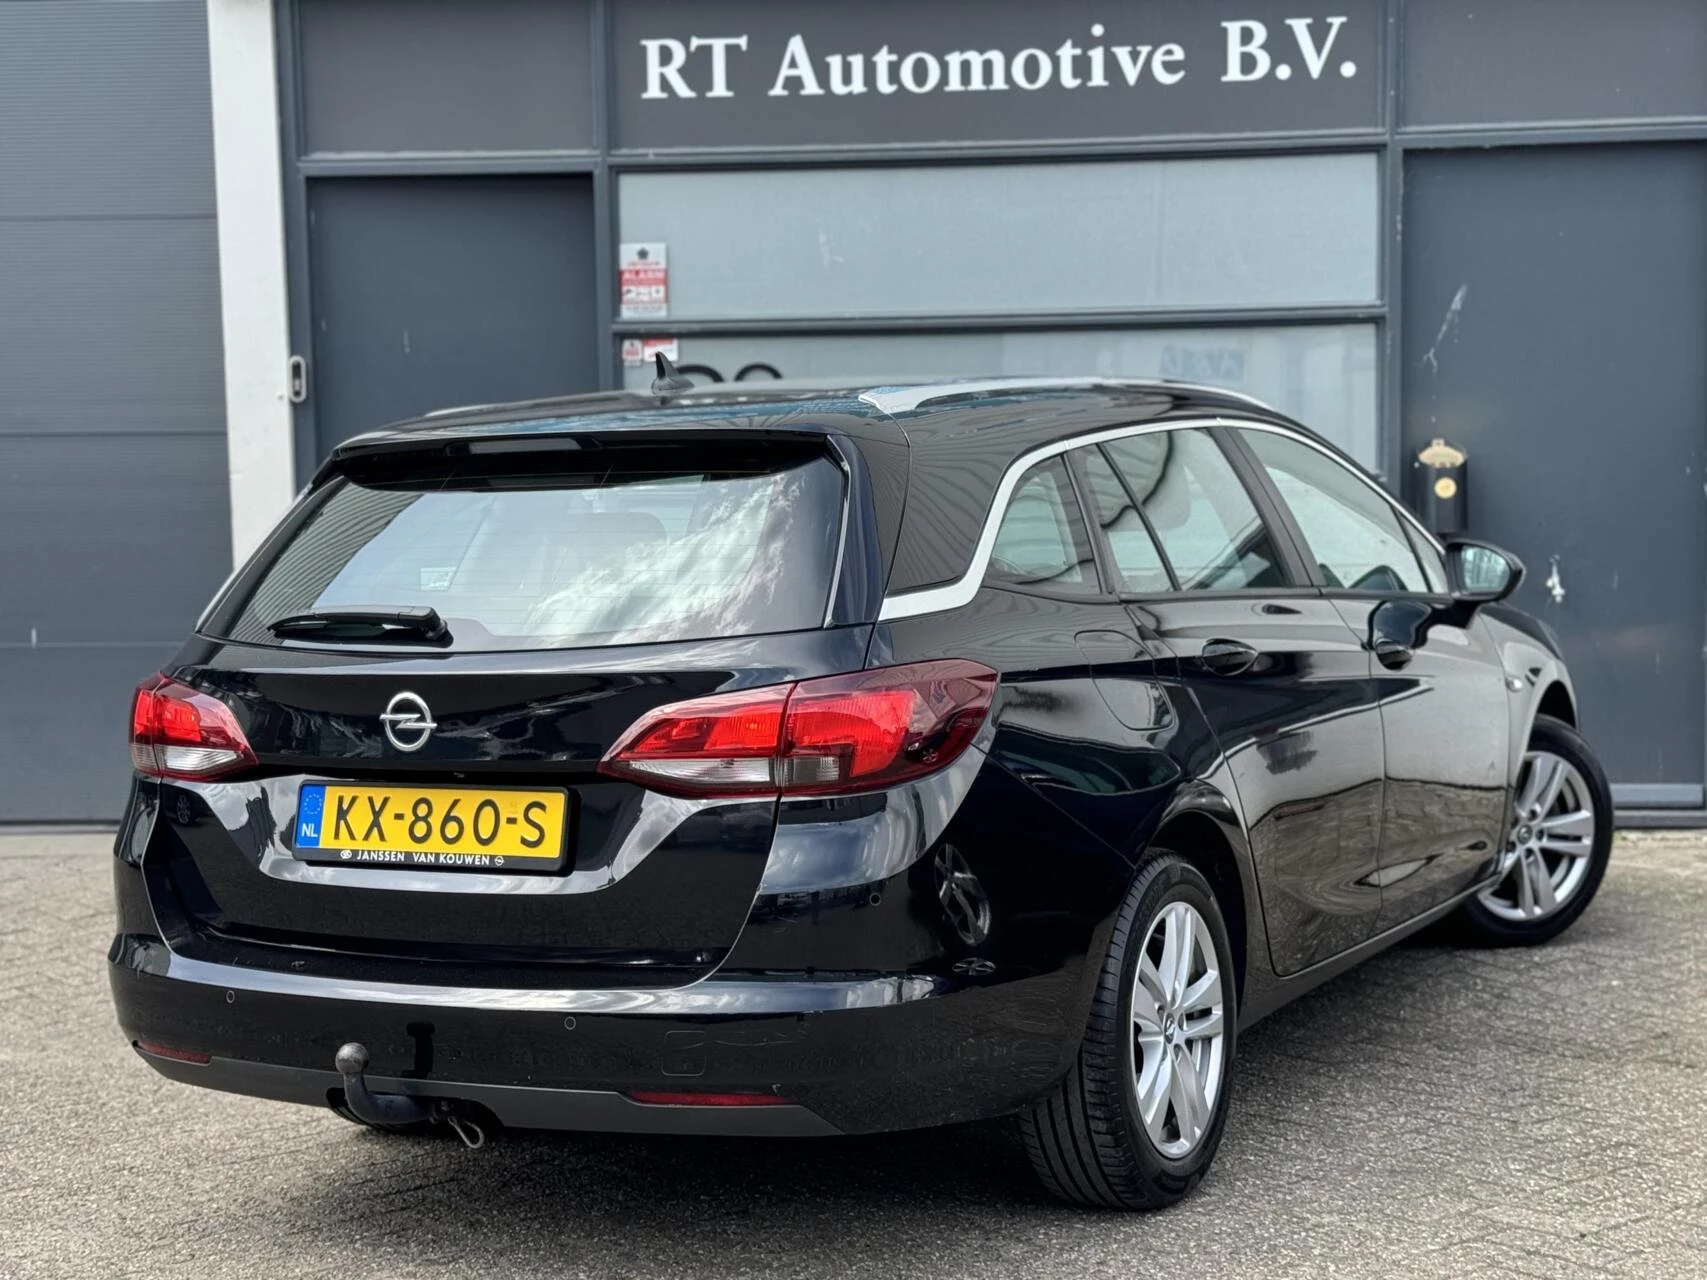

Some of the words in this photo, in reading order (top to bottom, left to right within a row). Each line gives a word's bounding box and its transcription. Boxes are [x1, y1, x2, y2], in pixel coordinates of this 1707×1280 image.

[640, 36, 748, 99] RT
[768, 24, 1186, 97] Automotive
[1220, 16, 1358, 82] B.V.
[301, 823, 318, 838] NL
[333, 795, 547, 849] KX-860-S
[357, 850, 405, 862] JANSSEN
[412, 852, 434, 863] VAN
[439, 853, 490, 865] KOUWEN
